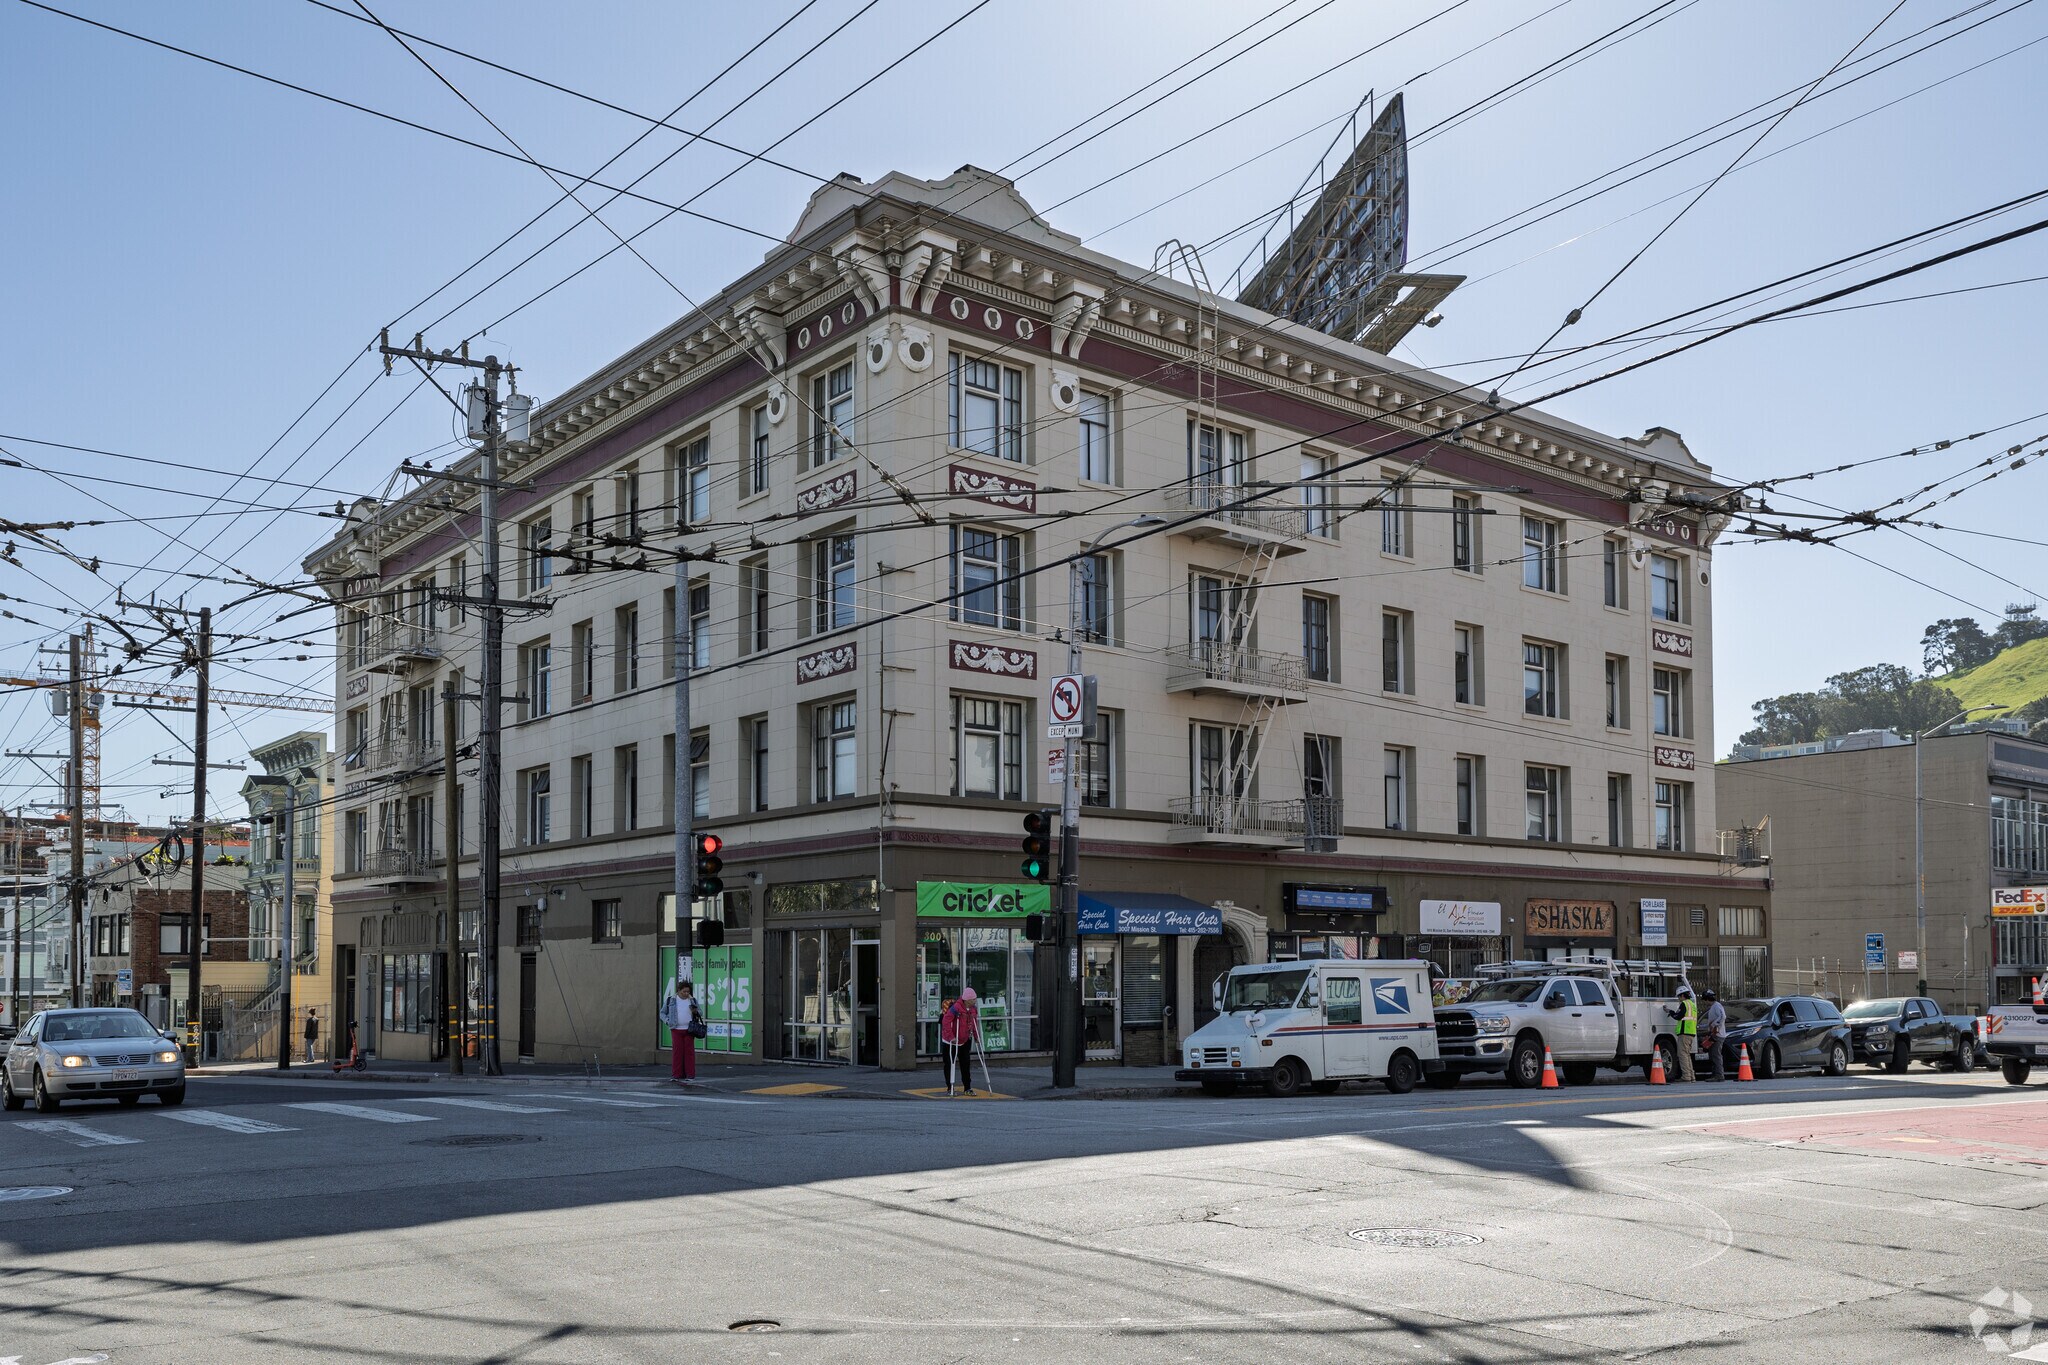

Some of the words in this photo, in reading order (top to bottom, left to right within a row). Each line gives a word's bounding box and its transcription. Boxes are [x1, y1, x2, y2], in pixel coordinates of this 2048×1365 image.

[943, 888, 1024, 913] cricket
[1995, 889, 2045, 904] FedEx
[1642, 900, 1651, 908] FOR
[1652, 900, 1665, 908] LEASE
[1081, 909, 1106, 921] Special
[1118, 909, 1161, 926] Special
[1164, 911, 1192, 925] Hair
[1194, 911, 1219, 927] Cuts
[1537, 905, 1604, 930] SHASKA
[1077, 919, 1093, 930] Hair
[1094, 919, 1110, 930] Cuts
[1274, 941, 1287, 949] 3011
[708, 958, 728, 971] family
[731, 958, 746, 971] plan
[969, 961, 988, 974] plan
[714, 1025, 723, 1034] 5G
[986, 1037, 1006, 1048] AT&T
